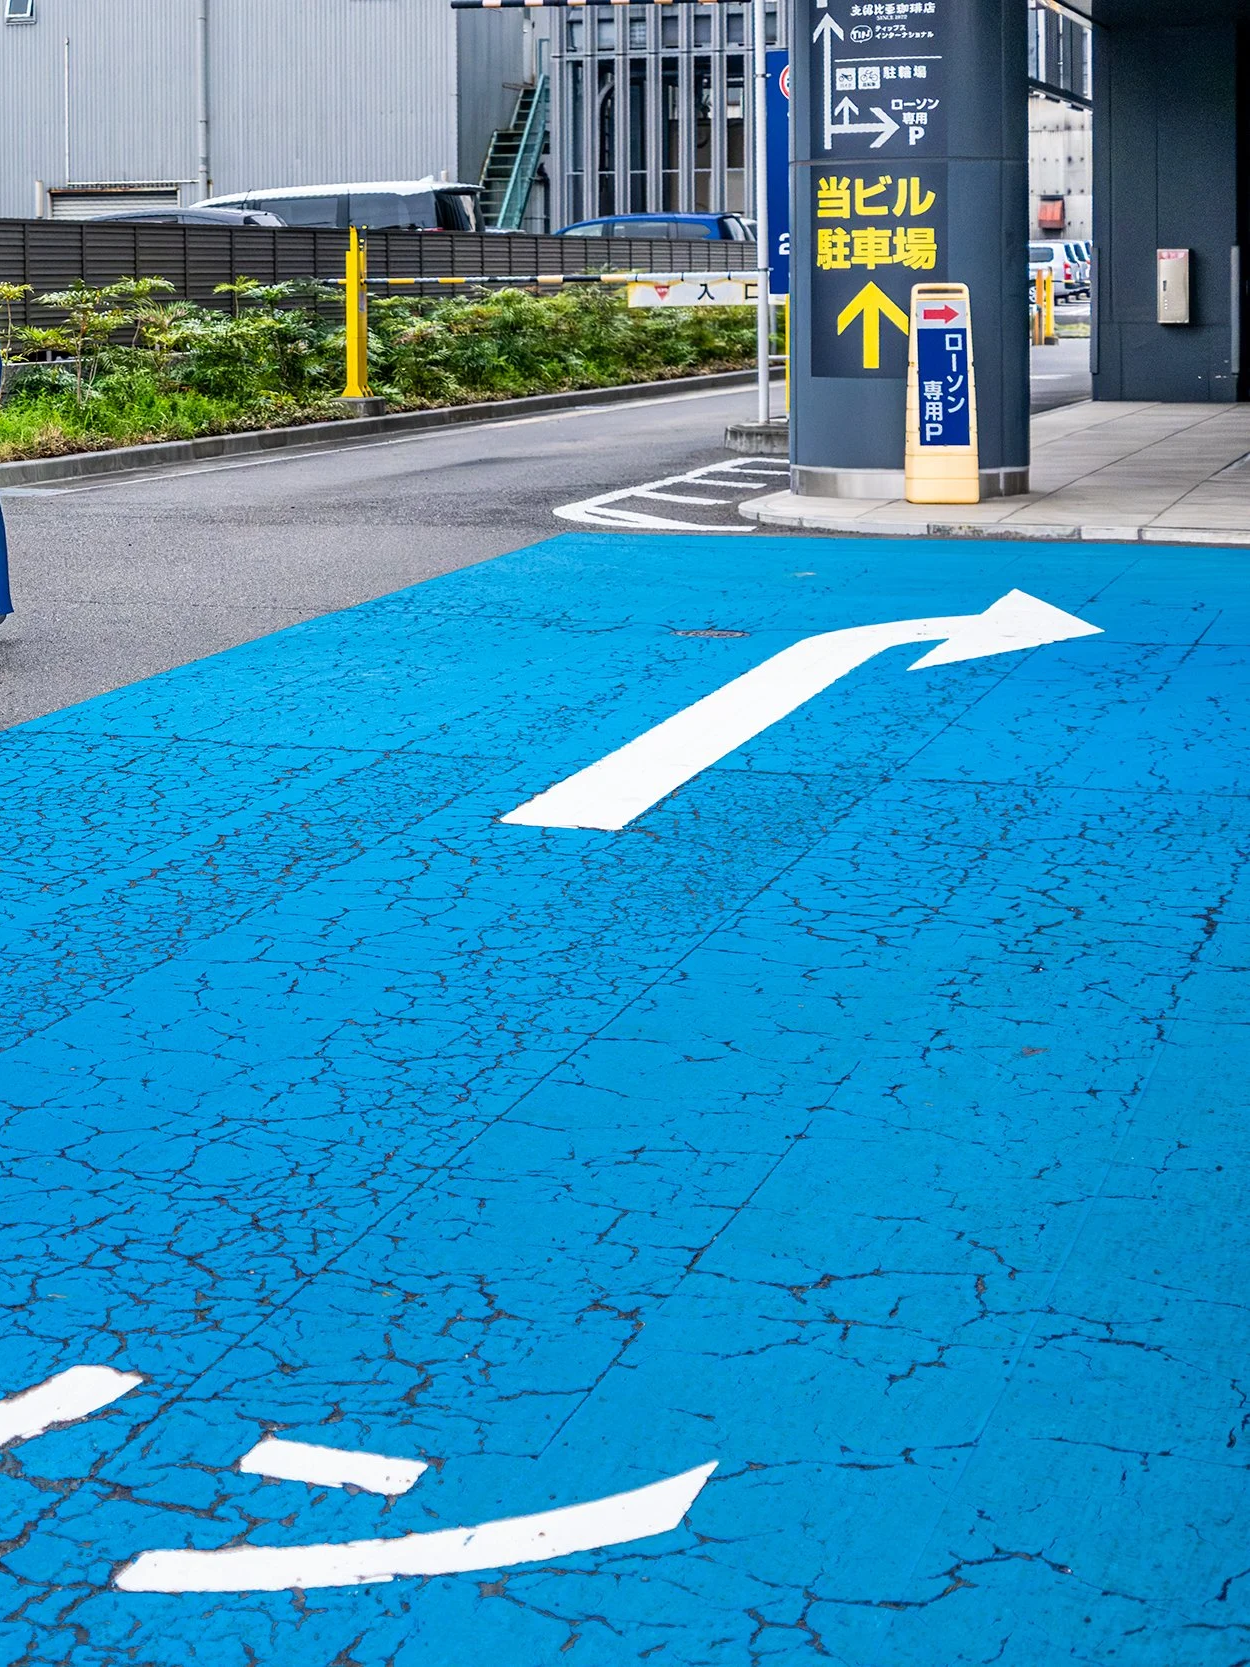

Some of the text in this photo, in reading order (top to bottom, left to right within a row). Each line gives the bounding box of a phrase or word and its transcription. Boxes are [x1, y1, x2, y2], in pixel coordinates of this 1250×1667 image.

[875, 24, 907, 32] ティップス
[875, 31, 935, 39] インターナショナル
[882, 65, 927, 79] 駐輪場
[891, 98, 940, 110] ローソン
[902, 112, 928, 125] 専用
[909, 126, 925, 145] P
[817, 175, 937, 219] 当ビル
[816, 226, 938, 270] 駐車場
[945, 333, 965, 414] ローソン
[923, 380, 944, 442] 専用P
